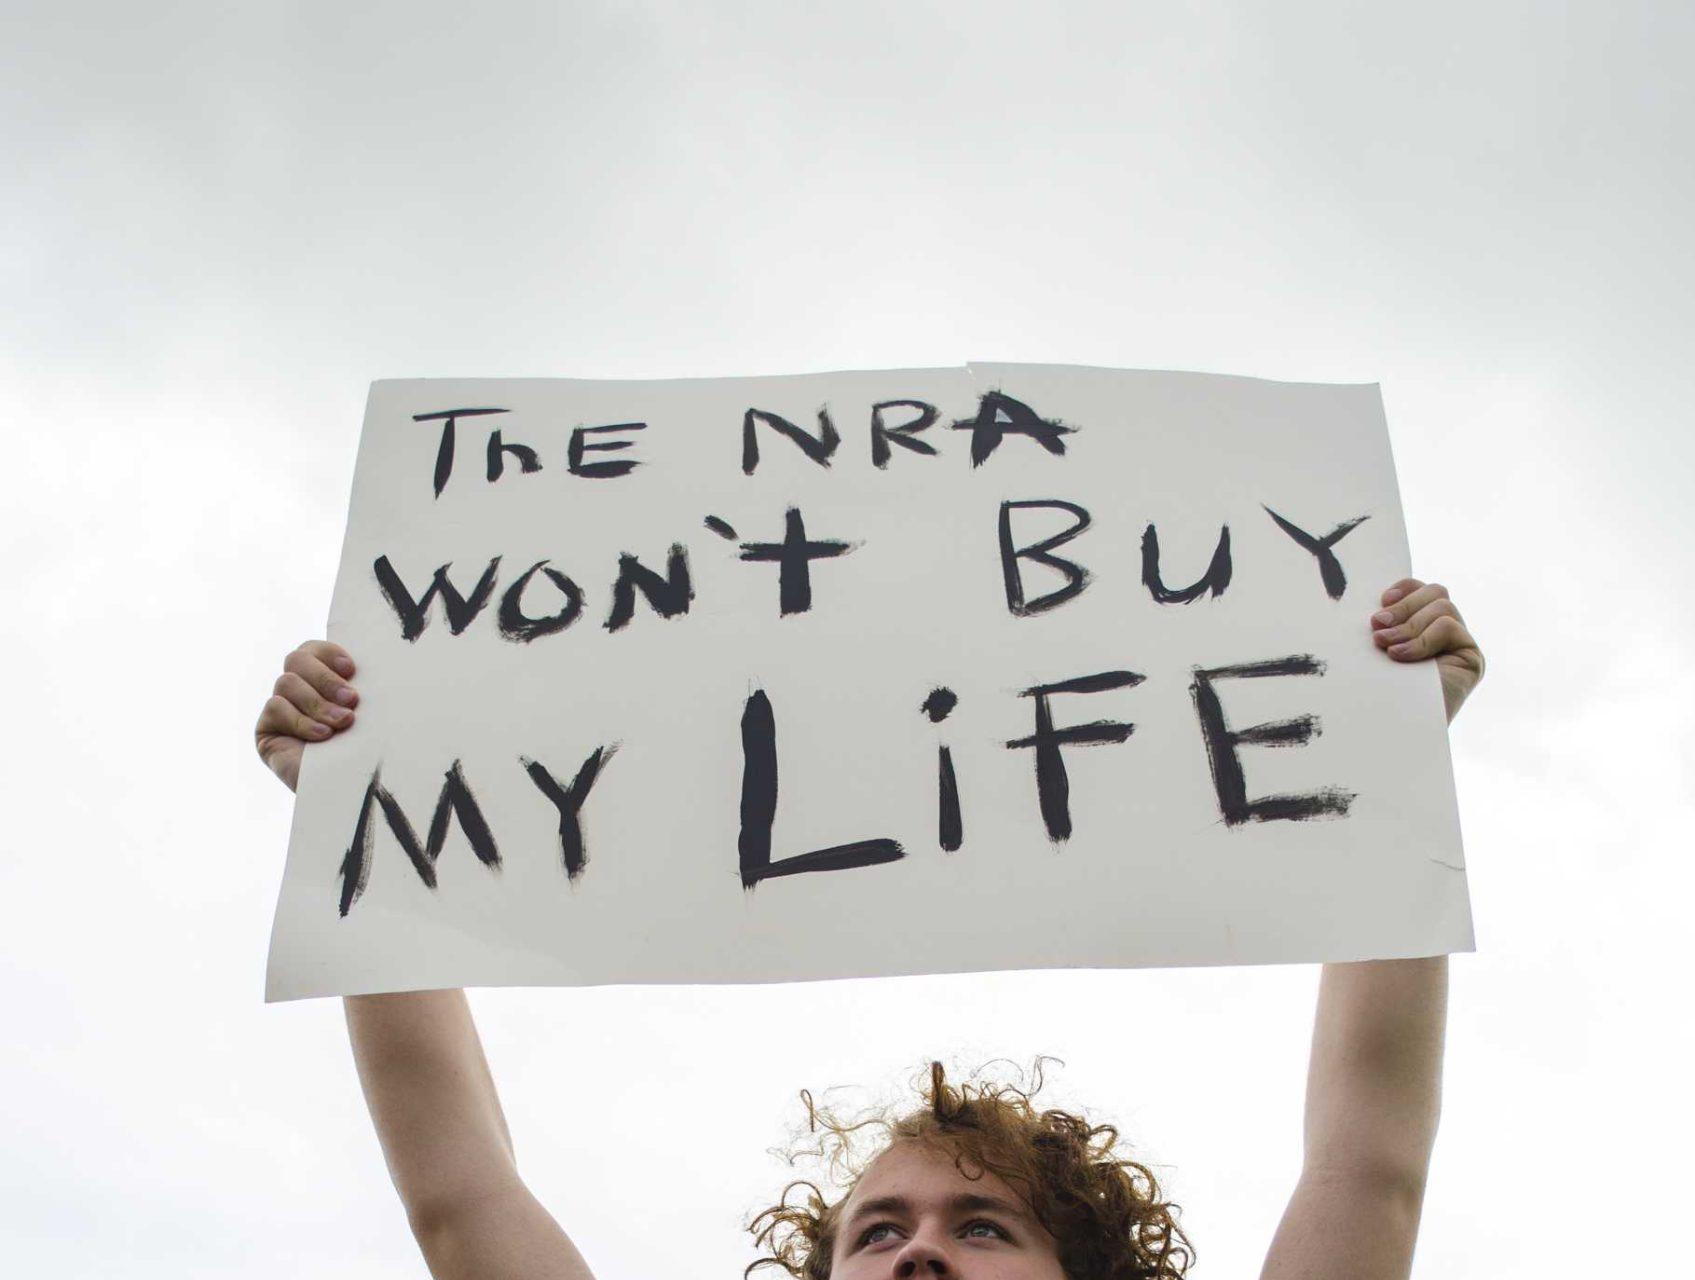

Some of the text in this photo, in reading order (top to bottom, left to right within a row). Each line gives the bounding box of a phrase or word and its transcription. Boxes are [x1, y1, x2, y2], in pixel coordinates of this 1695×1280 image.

[742, 389, 1079, 475] NRA
[999, 499, 1371, 617] BUY
[339, 740, 622, 918] MY
